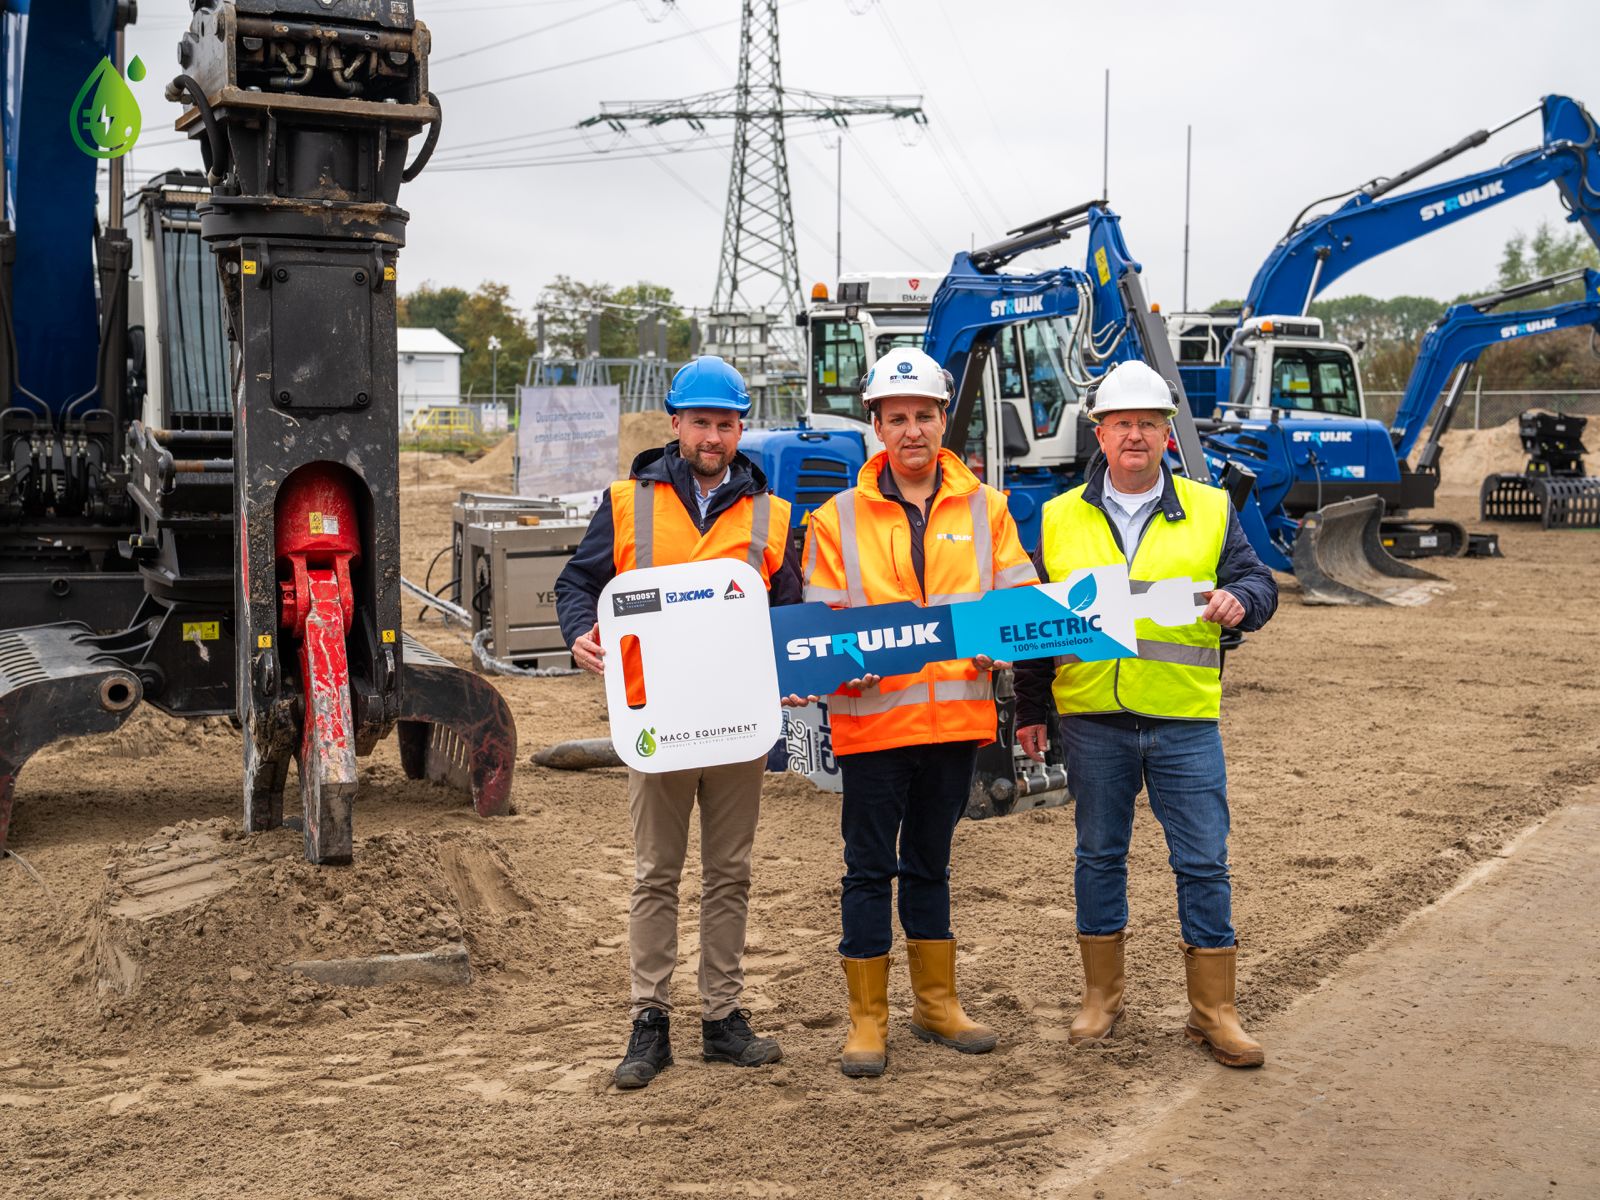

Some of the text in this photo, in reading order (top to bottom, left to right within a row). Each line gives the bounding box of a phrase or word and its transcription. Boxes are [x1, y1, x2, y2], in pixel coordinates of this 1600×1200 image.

[1420, 179, 1505, 221] STRUIJK
[991, 294, 1043, 317] STRUIJK
[1501, 317, 1556, 338] STRUIJK
[1293, 431, 1352, 448] STRUIJK
[536, 591, 557, 603] YE
[625, 592, 656, 602] TROOST
[678, 589, 715, 602] XCMG
[1000, 614, 1102, 643] ELECTRIC
[786, 621, 942, 669] STRUIJK
[1013, 637, 1094, 653] 100% emissieloos
[660, 723, 758, 743] MACO EQUIPMENT
[788, 720, 809, 775] 275
